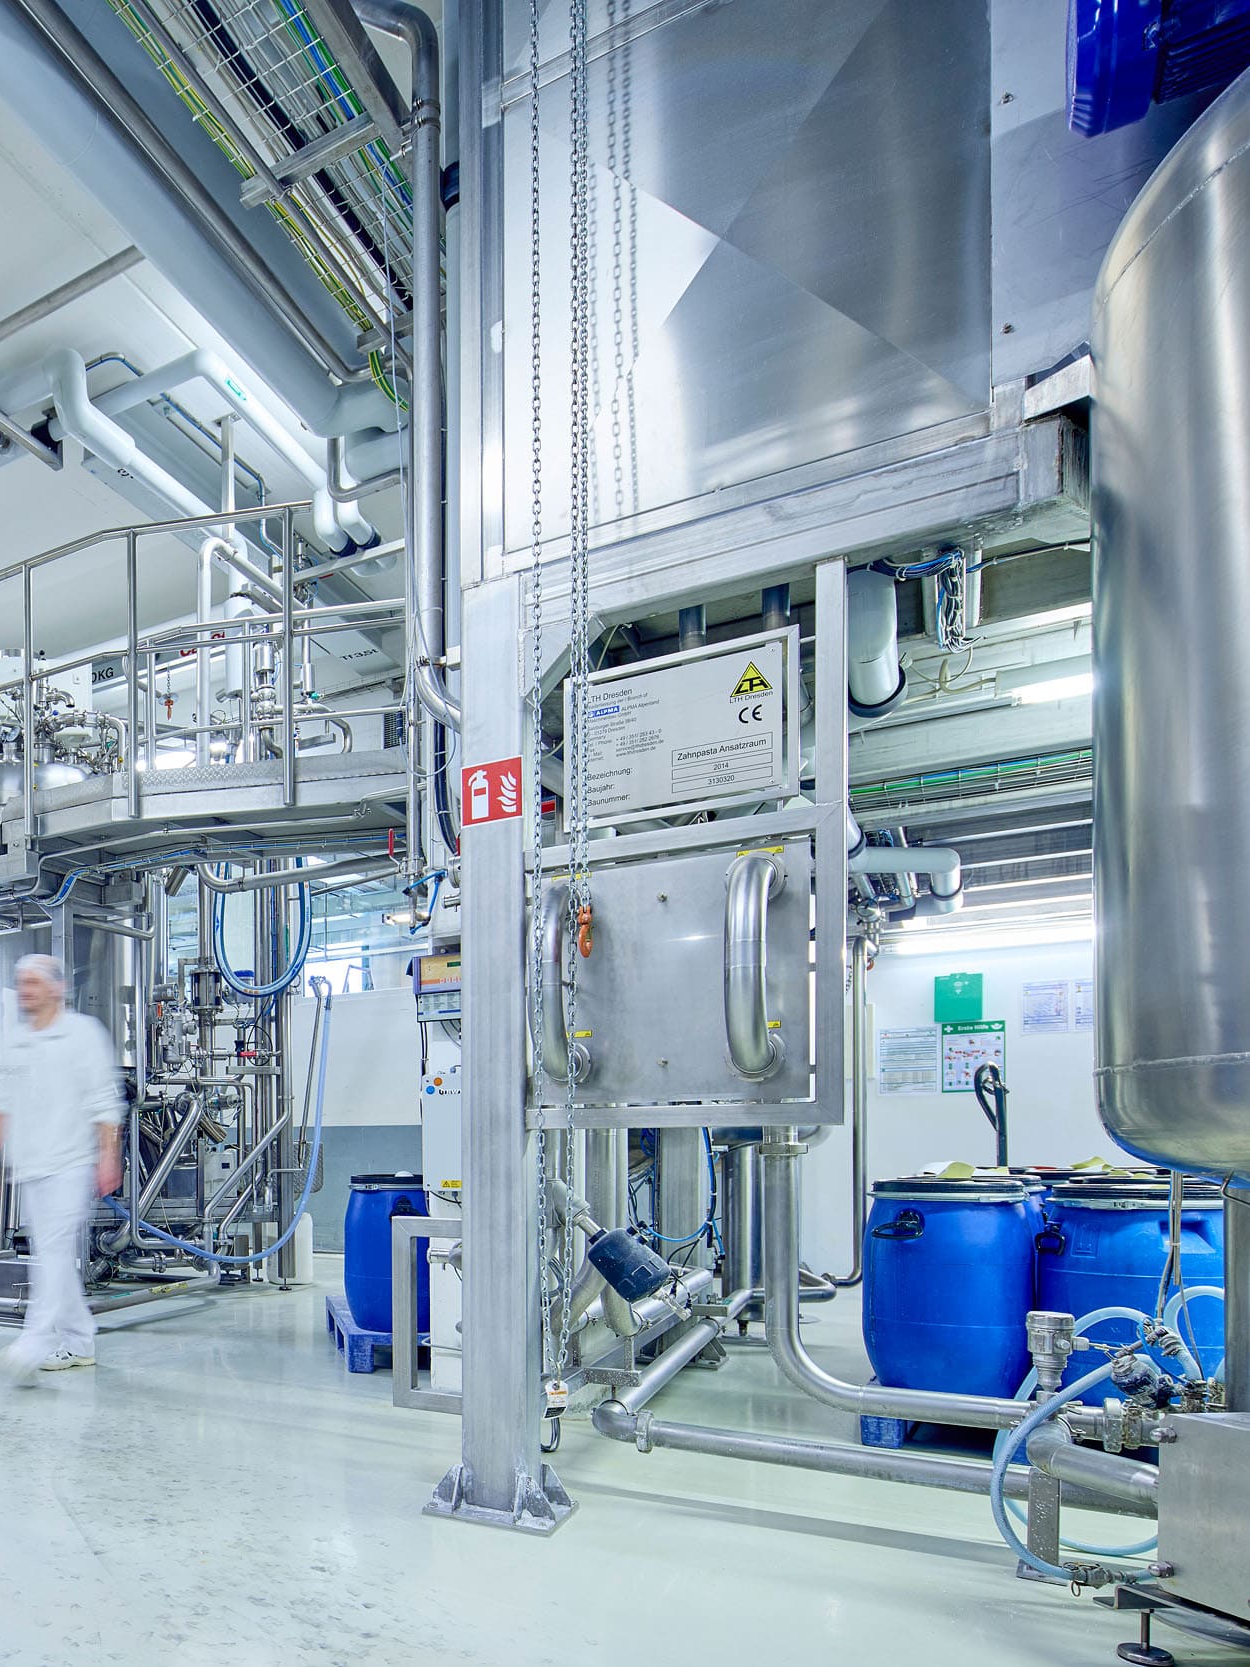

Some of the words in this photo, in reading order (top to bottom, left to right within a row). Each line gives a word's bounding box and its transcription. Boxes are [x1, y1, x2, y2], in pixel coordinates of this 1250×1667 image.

[603, 688, 632, 701] Dresden
[729, 696, 743, 704] LTH
[744, 690, 774, 701] Dresden
[596, 707, 619, 716] ALPMA
[677, 748, 718, 761] Zahnpasta
[719, 738, 767, 753] Ansatzraum
[713, 762, 729, 770] 2014
[587, 767, 633, 781] Bezeichnung:
[708, 775, 735, 785] 3130320
[587, 783, 615, 794] Baujahr:
[587, 794, 631, 807] Baunummer:
